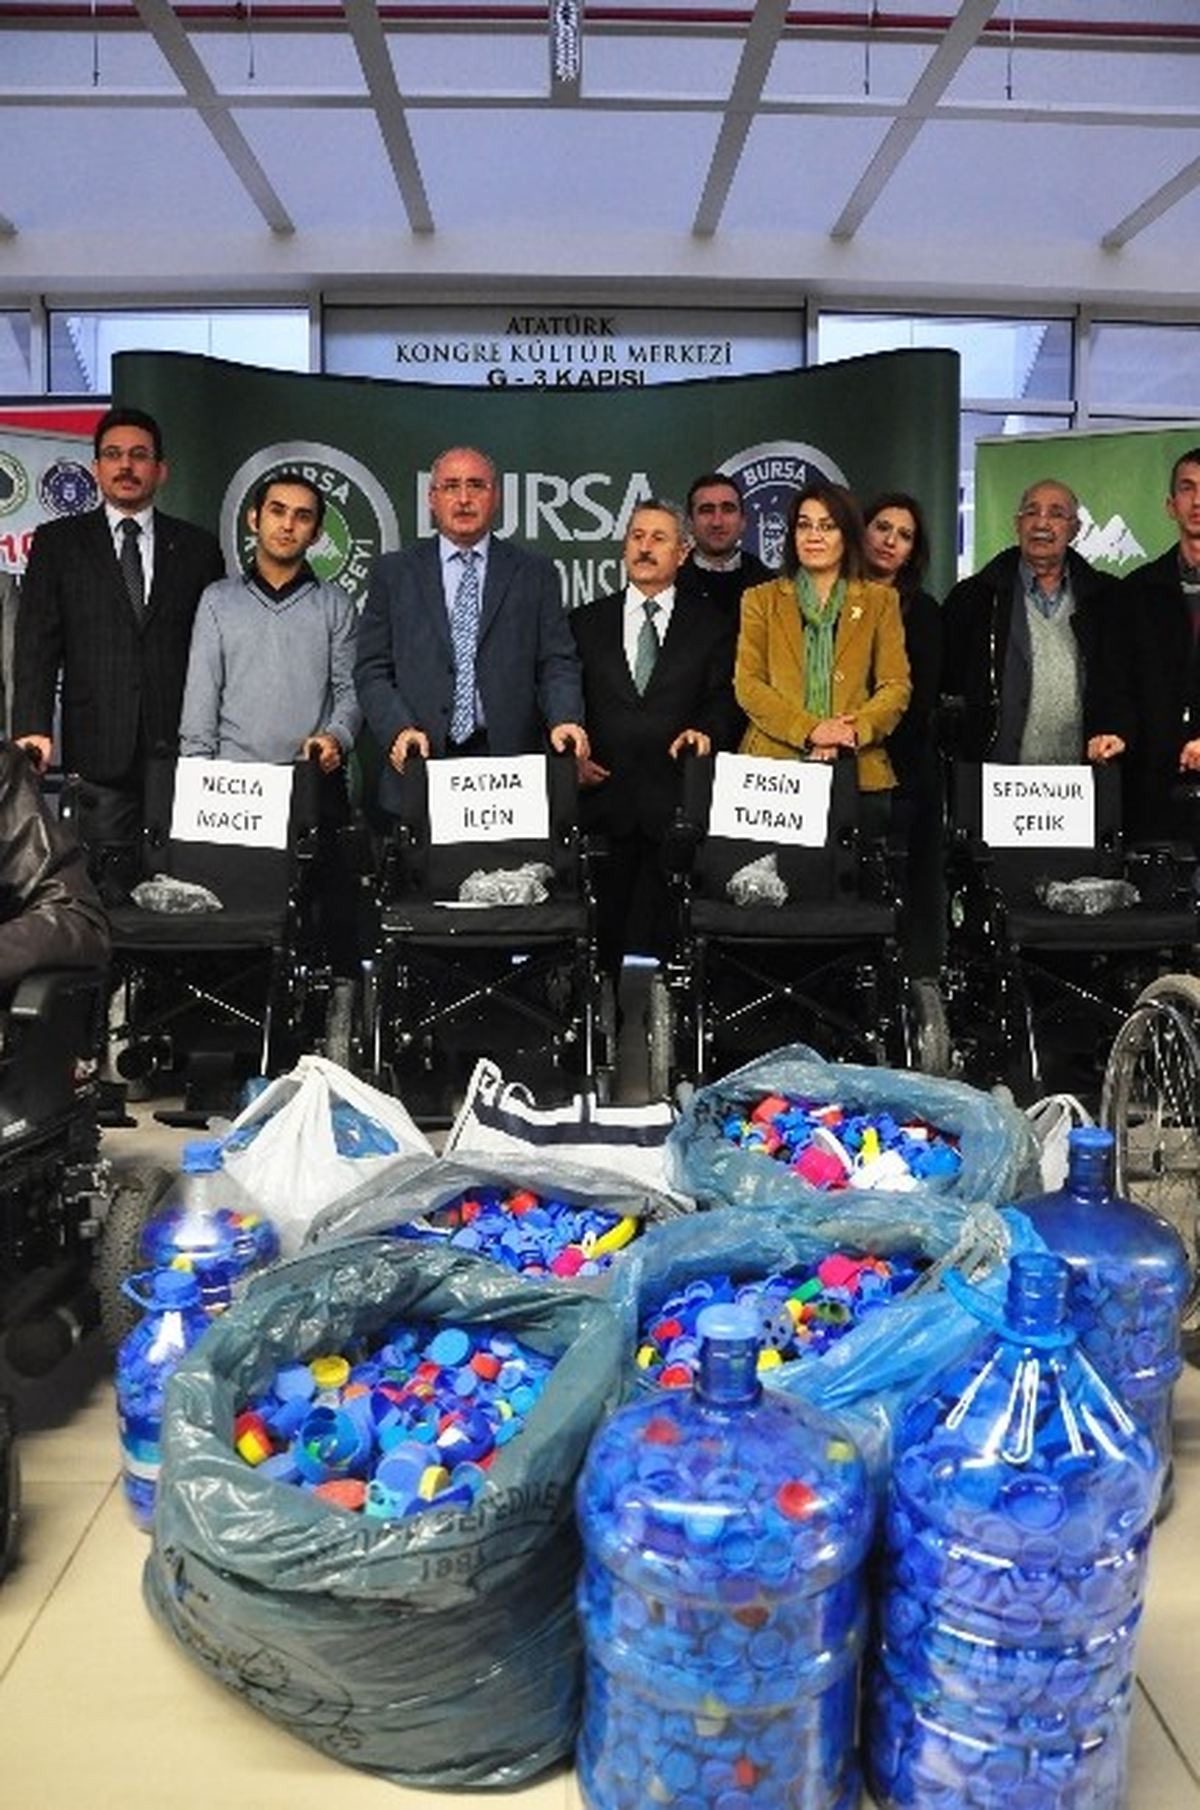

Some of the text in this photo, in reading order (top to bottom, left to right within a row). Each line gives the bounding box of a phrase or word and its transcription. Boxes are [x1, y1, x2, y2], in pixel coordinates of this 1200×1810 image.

[506, 314, 616, 337] ATATÜRK
[397, 340, 732, 365] KONGRE KÜLTÜR MERKEZİ
[487, 369, 507, 387] G
[534, 370, 547, 388] 3
[744, 460, 806, 486] BURSA
[450, 773, 522, 792] FATMA
[742, 773, 801, 795] ERSİN
[993, 781, 1083, 800] SEDANUR
[197, 810, 263, 831] MACİT
[464, 804, 514, 831] İLÇİN
[734, 807, 803, 831] TURAN
[1013, 815, 1064, 836] ÇELİK
